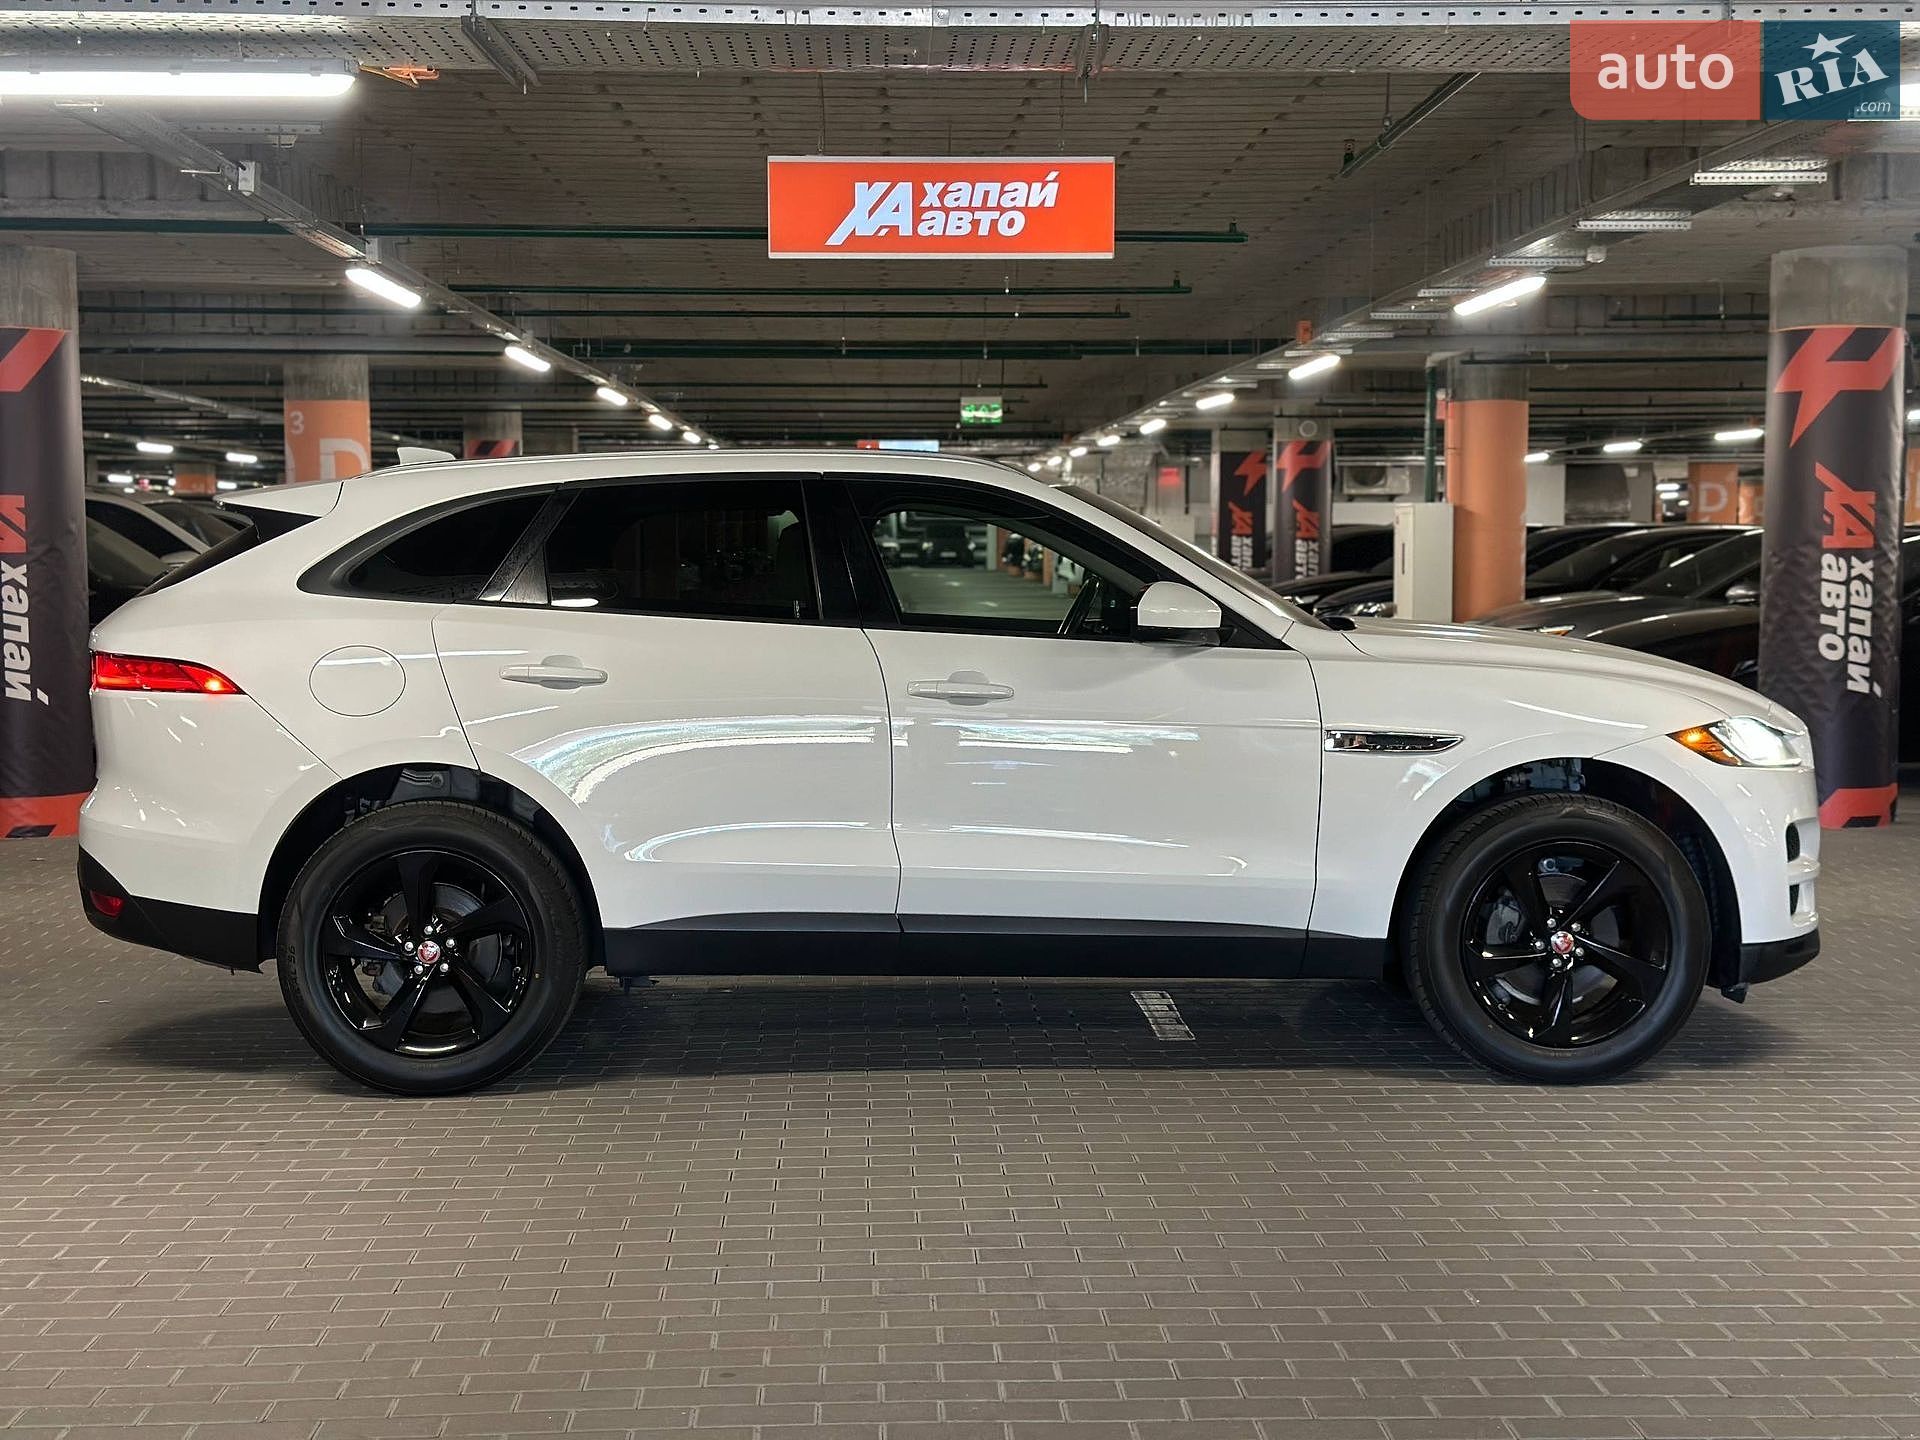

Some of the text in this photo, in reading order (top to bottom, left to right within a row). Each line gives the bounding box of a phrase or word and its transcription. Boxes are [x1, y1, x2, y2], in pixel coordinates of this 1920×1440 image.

[917, 210, 1025, 236] авто
[919, 171, 1060, 207] хапай
[290, 411, 304, 434] 3
[0, 560, 49, 706] хапай
[1818, 553, 1848, 661] авто
[1846, 555, 1882, 698] хапай
